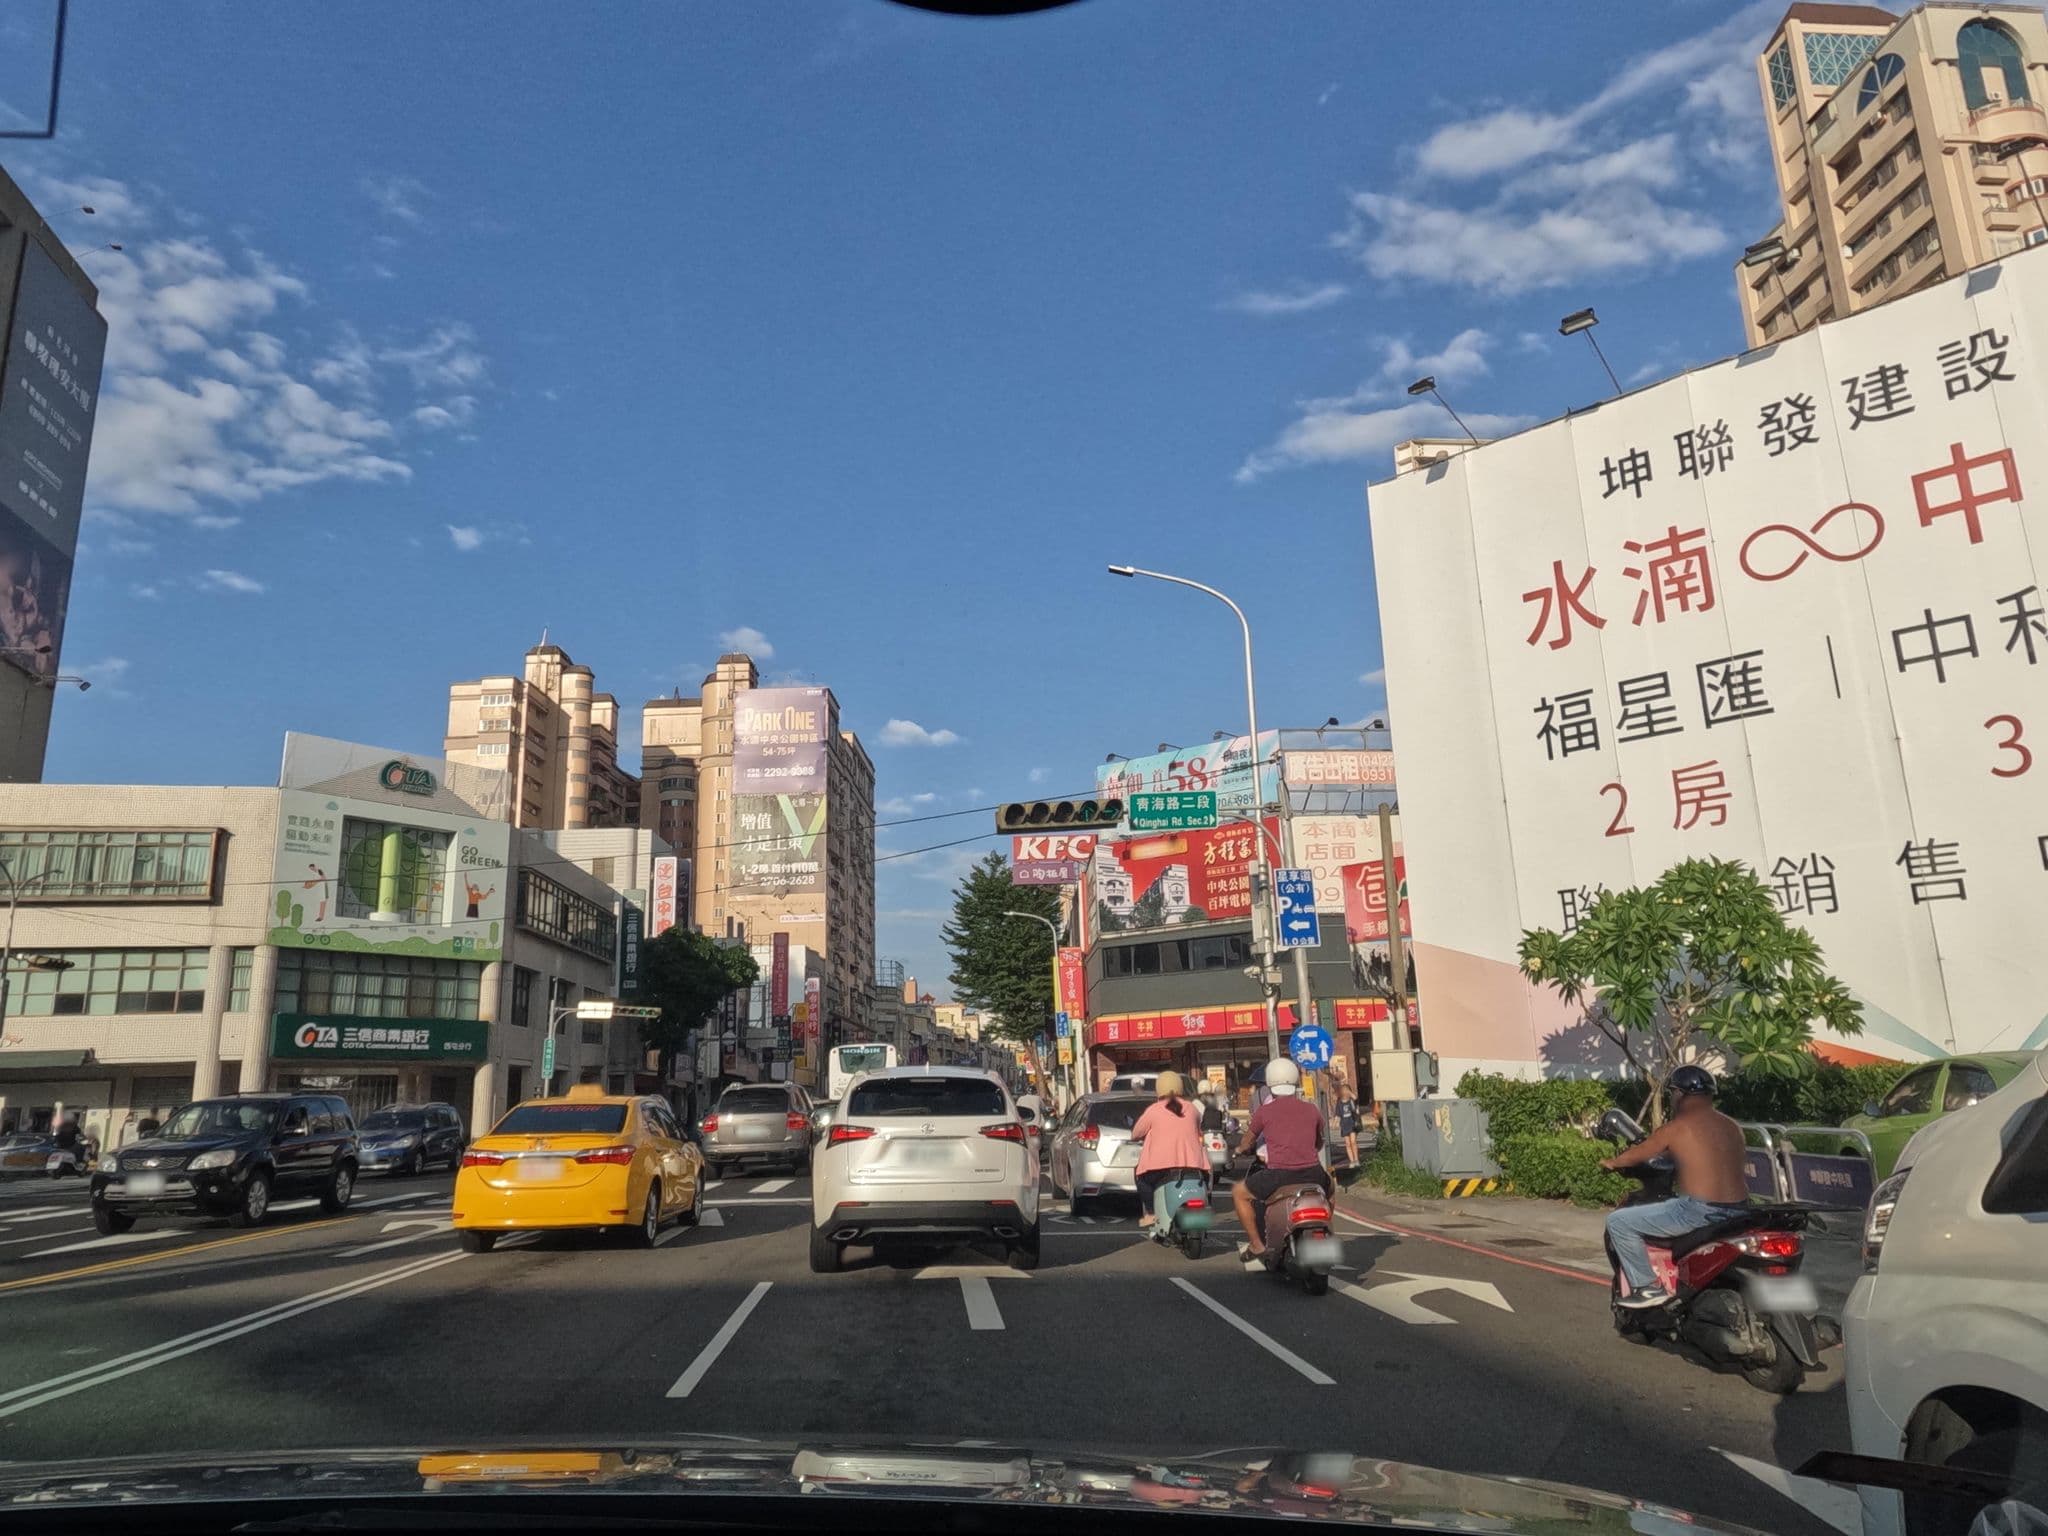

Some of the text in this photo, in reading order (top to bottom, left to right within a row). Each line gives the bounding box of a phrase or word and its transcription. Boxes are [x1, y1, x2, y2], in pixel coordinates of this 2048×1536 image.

[1599, 327, 2016, 500] 坤聯發建設
[1522, 525, 1716, 651] 水湳
[1533, 649, 1775, 761] 福星匯
[744, 705, 815, 731] PARK ONE
[1169, 757, 1208, 792] 58
[1289, 753, 1360, 782] 廣告出租
[1599, 714, 2033, 837] 2房 3
[1136, 795, 1210, 812] 青海路二段
[740, 812, 772, 830] 增值
[1139, 814, 1209, 830] Qinghai Rd. Sec.2
[462, 845, 479, 856] GO
[740, 832, 803, 852] 才是上策
[1017, 835, 1092, 860] KFC
[461, 854, 501, 867] GREEN
[1032, 867, 1069, 880] 陶板屋
[1277, 870, 1312, 883] 星享道
[1206, 875, 1250, 894] 中央公園
[1557, 837, 1967, 935] 聯銷售
[1207, 891, 1252, 912] 百坪電梯
[1346, 1007, 1366, 1020] 牛丼
[343, 1027, 430, 1043] 三信商業銀行
[1136, 1021, 1154, 1033] 牛丼
